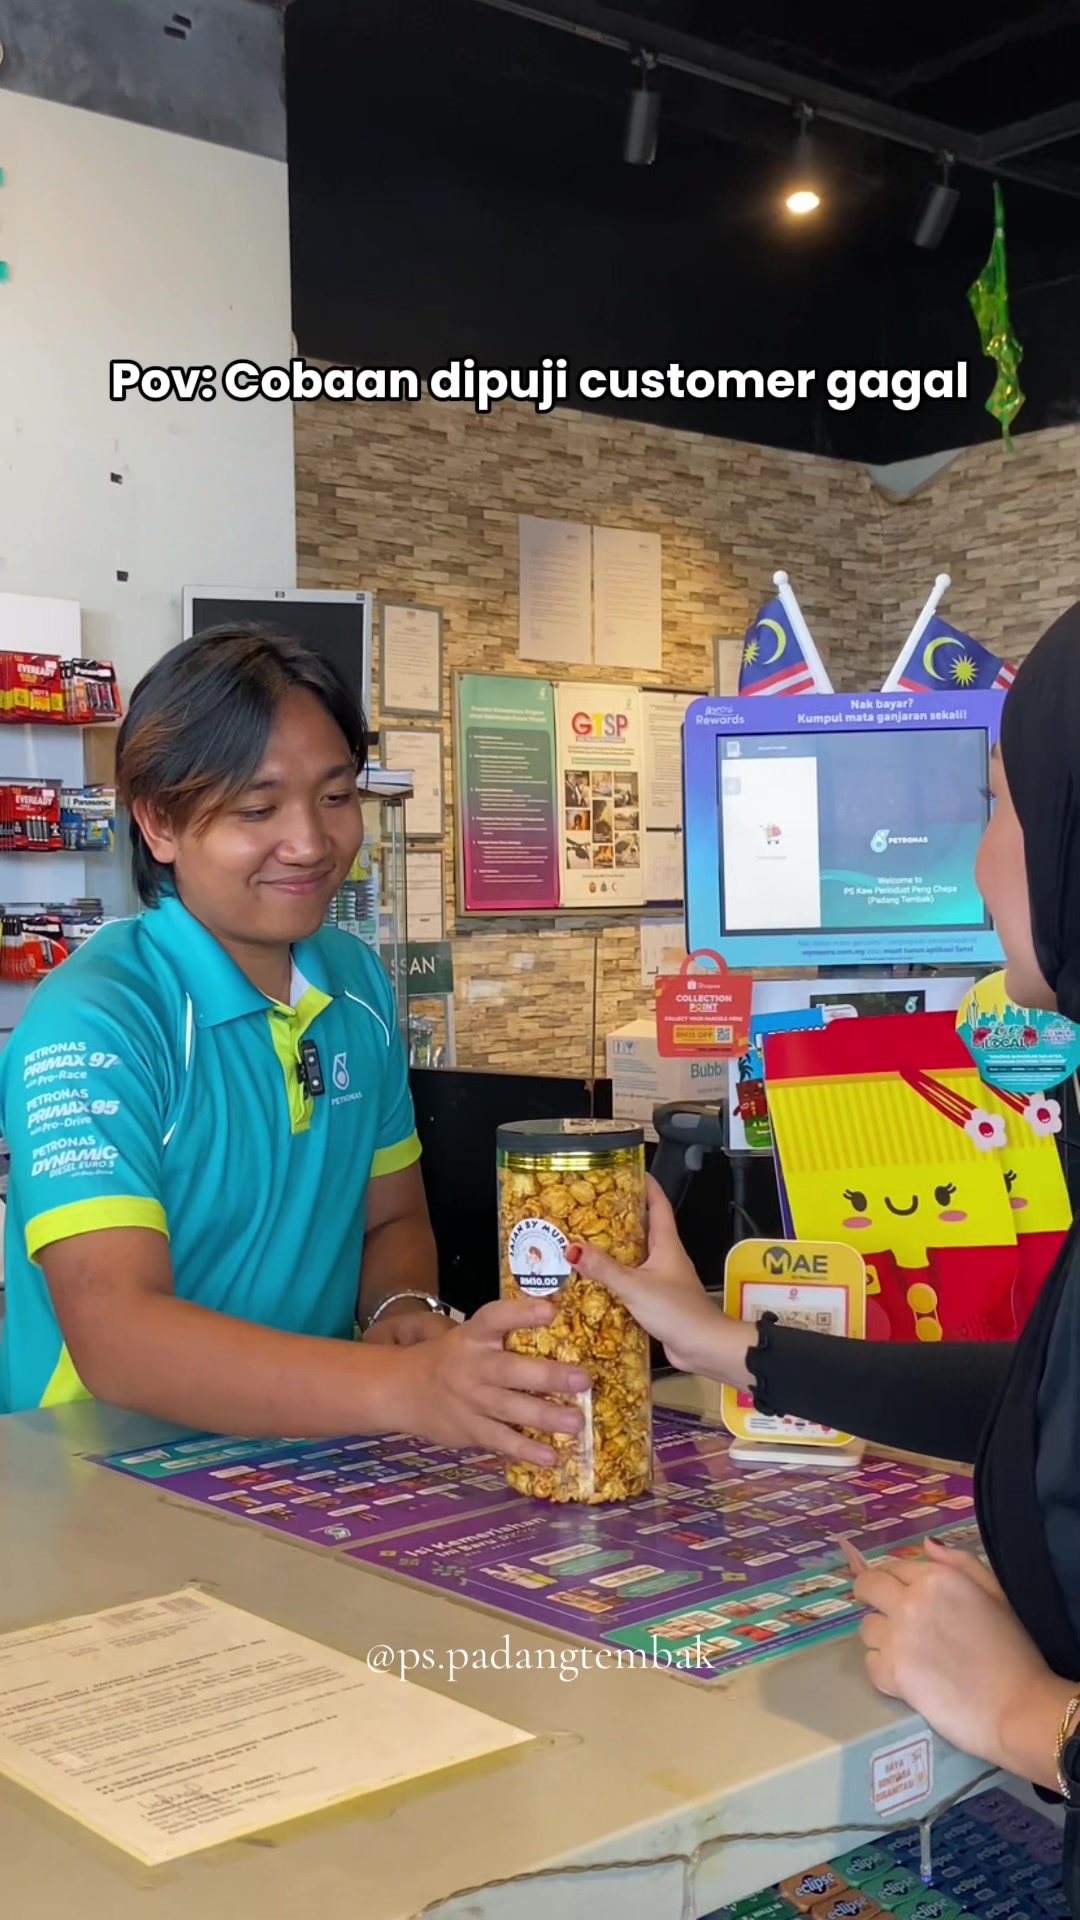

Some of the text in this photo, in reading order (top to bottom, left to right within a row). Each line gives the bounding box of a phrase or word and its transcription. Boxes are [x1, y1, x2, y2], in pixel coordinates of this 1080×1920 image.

[851, 698, 914, 711] Nak bayar?
[571, 711, 629, 738] GTSP
[695, 714, 745, 725] Rewards
[797, 709, 968, 725] Kumpul mata ganjaran sekali!
[73, 798, 111, 806] Panasonic
[888, 836, 928, 845] PETRONAS
[877, 876, 923, 885] Welcome to
[843, 887, 855, 895] PS
[912, 886, 931, 895] Peng
[867, 895, 934, 905] (Padang Tembak)
[675, 994, 733, 1002] COLLECTION
[689, 1002, 718, 1011] POINT
[24, 1041, 87, 1066] PETRONAS
[23, 1052, 118, 1081] PRIMAX 97
[37, 1070, 88, 1086] Pro-Race
[26, 1088, 89, 1112] PETRONAS
[331, 1091, 362, 1106] PETRONAS
[27, 1099, 120, 1128] PRIMAX 95
[42, 1116, 92, 1133] Pro-Drive
[33, 1135, 96, 1160] PETRONAS
[31, 1145, 119, 1177] DYNAMIC
[50, 1160, 77, 1178] DIESEL
[78, 1160, 107, 1169] EURO
[525, 1220, 538, 1230] BY
[762, 1246, 829, 1276] MAE
[846, 1851, 884, 1875] eclipse
[795, 1871, 836, 1897] eclipse
[877, 1875, 917, 1899] eclipse
[953, 1873, 988, 1895] eclipse
[828, 1895, 870, 1920] eclipse
